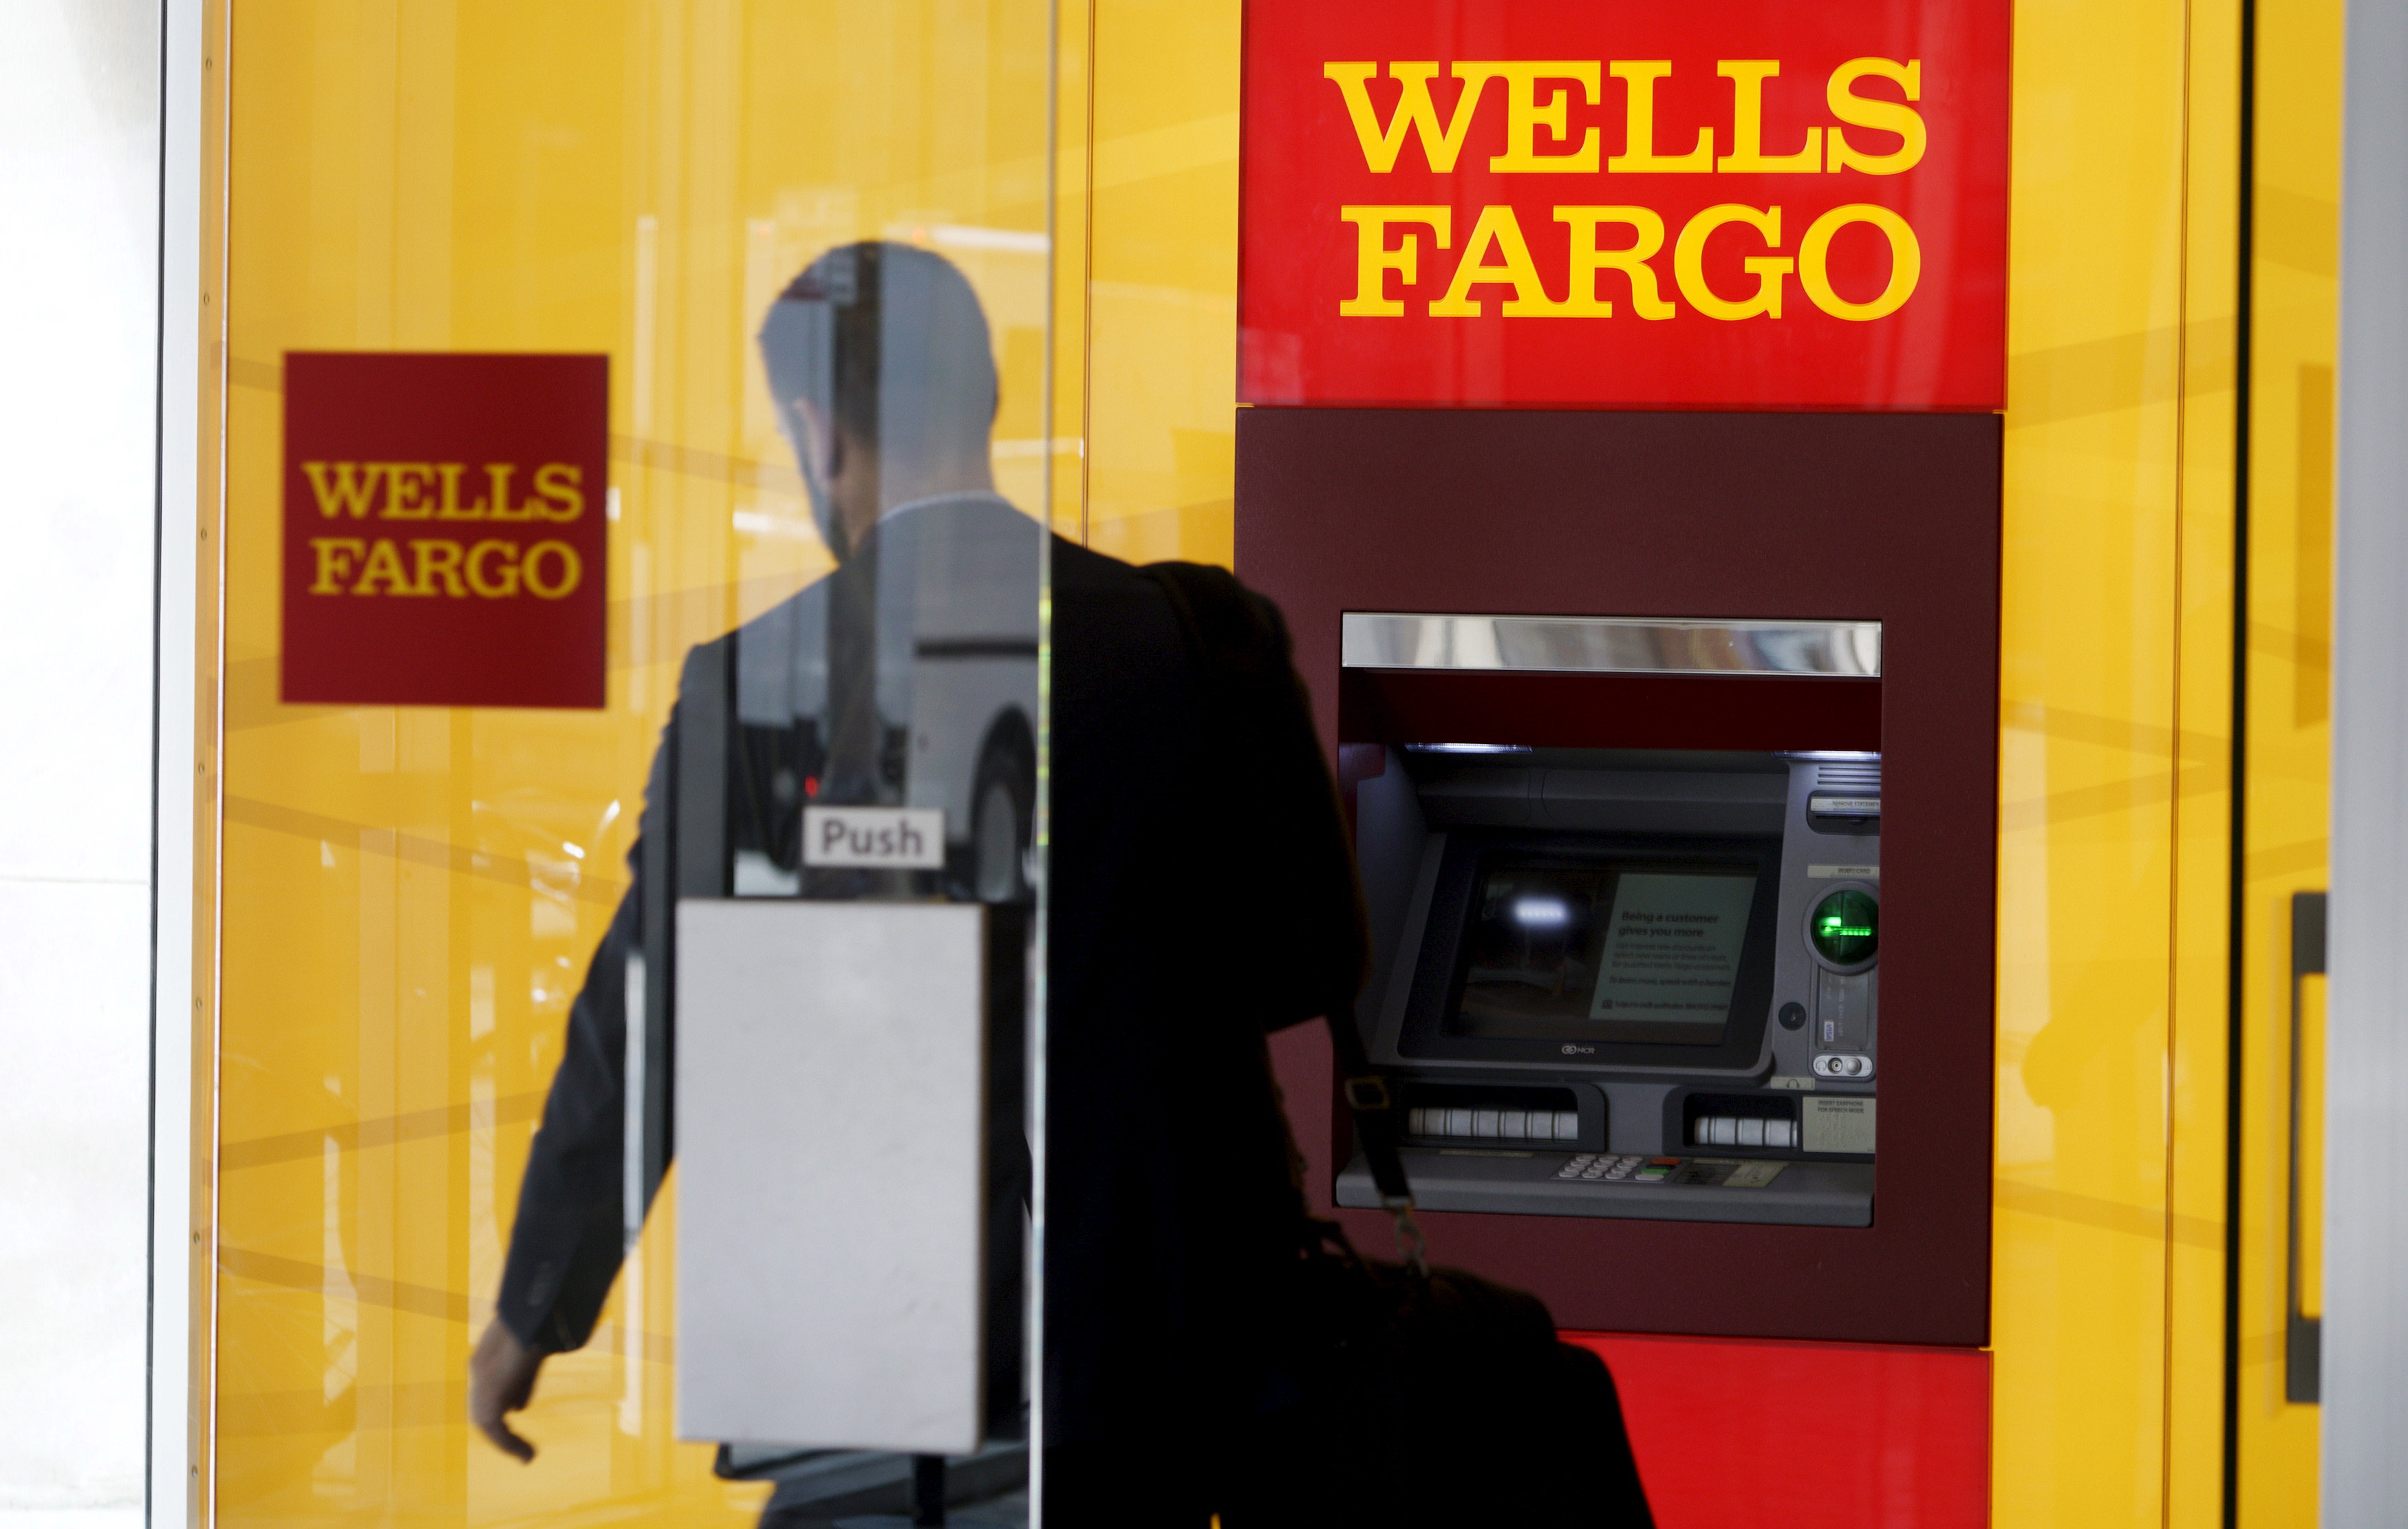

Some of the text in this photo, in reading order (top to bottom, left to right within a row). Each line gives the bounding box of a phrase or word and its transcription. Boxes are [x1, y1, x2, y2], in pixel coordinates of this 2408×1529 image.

[1324, 56, 1927, 175] WELLS
[1340, 203, 1921, 321] FARGO
[300, 461, 585, 523] WELLS
[307, 537, 582, 600] FARGO
[822, 817, 924, 857] Push
[1618, 926, 1648, 937] gives
[1651, 929, 1672, 937] you
[1622, 911, 1654, 923] Being
[1665, 913, 1719, 923] customer
